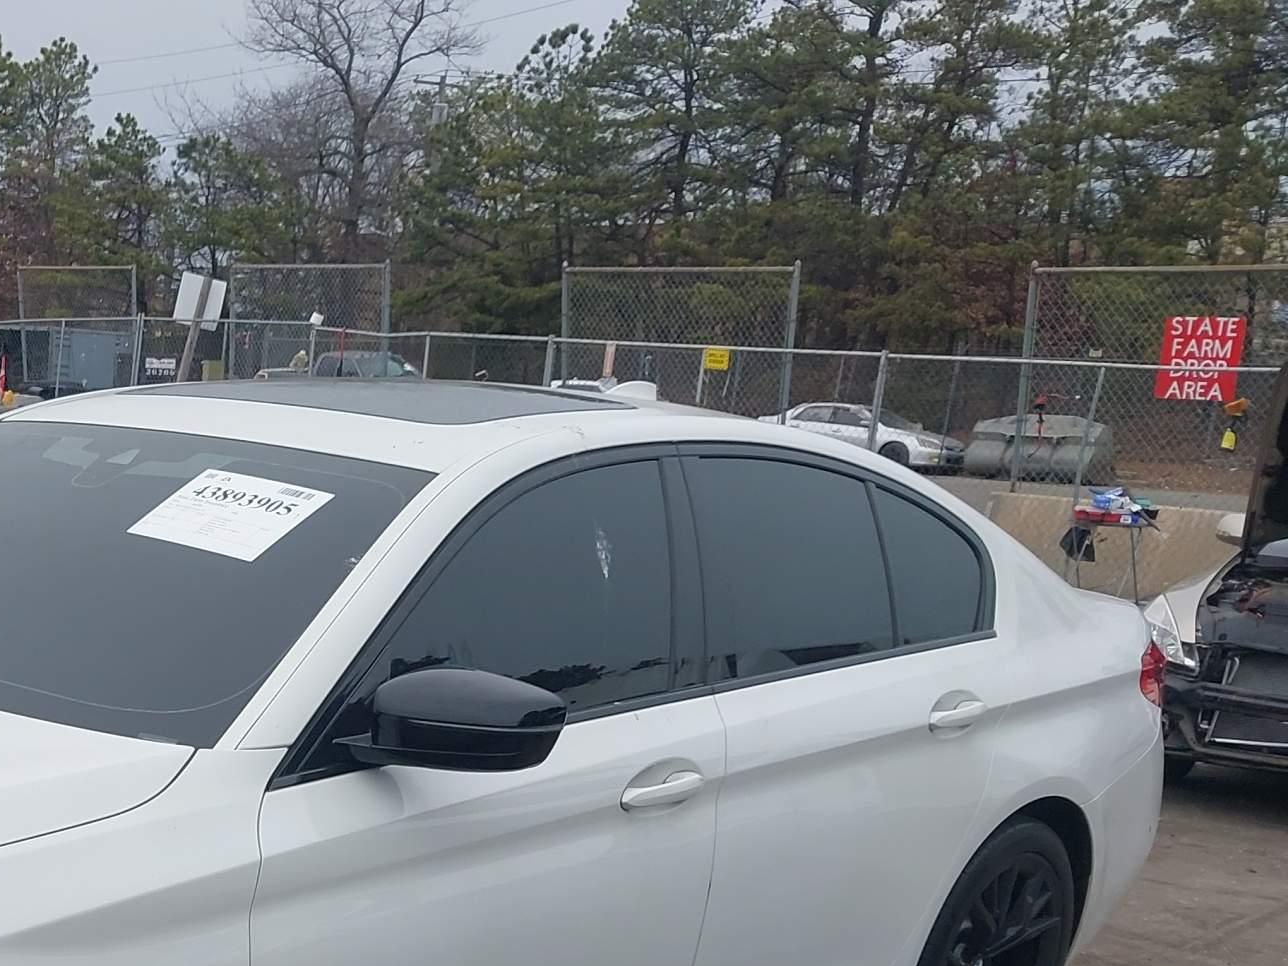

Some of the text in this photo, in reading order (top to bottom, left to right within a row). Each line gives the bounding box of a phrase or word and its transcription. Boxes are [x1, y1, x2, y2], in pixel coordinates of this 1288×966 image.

[1171, 317, 1239, 336] STATE
[1171, 338, 1233, 358] FARM
[1169, 358, 1227, 378] DROP
[1165, 381, 1222, 401] AREA
[193, 485, 298, 515] 43893905
